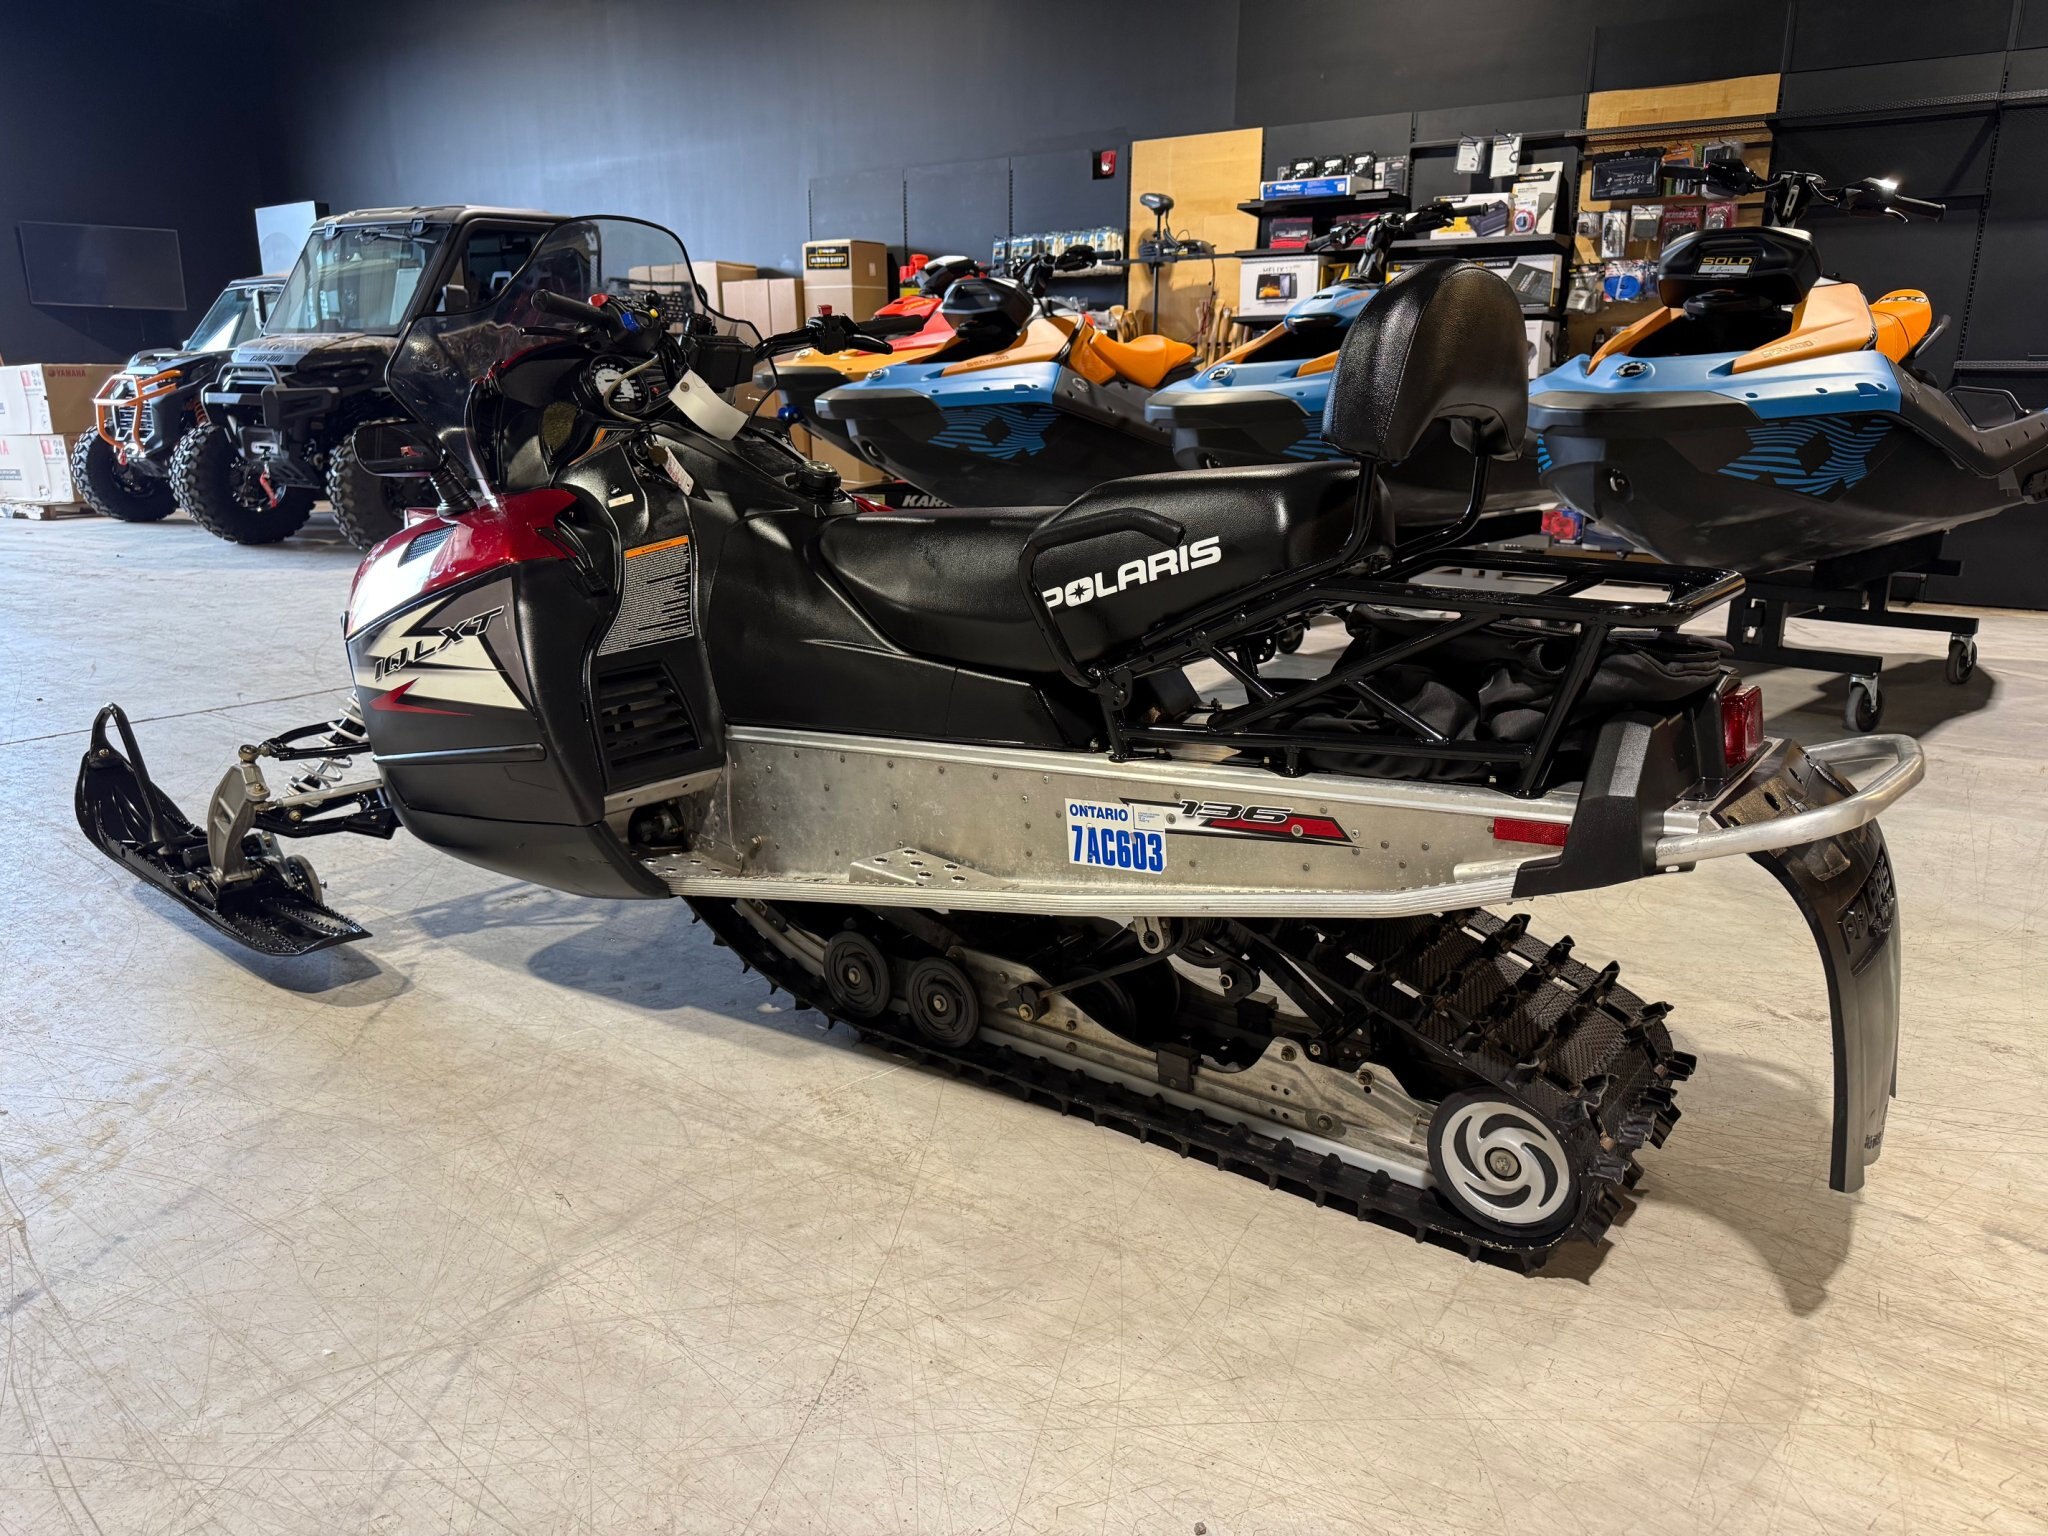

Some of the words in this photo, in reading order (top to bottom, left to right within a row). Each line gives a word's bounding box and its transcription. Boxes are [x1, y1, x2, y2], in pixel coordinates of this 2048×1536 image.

[1701, 257, 1753, 266] SOLD
[56, 369, 86, 378] YAMAHA
[1042, 535, 1222, 608] POLARIS
[374, 646, 410, 682] IQ
[412, 605, 505, 663] LXT
[1069, 803, 1129, 822] ONTARIO
[1178, 798, 1295, 825] 136
[1071, 824, 1164, 872] 7AC603
